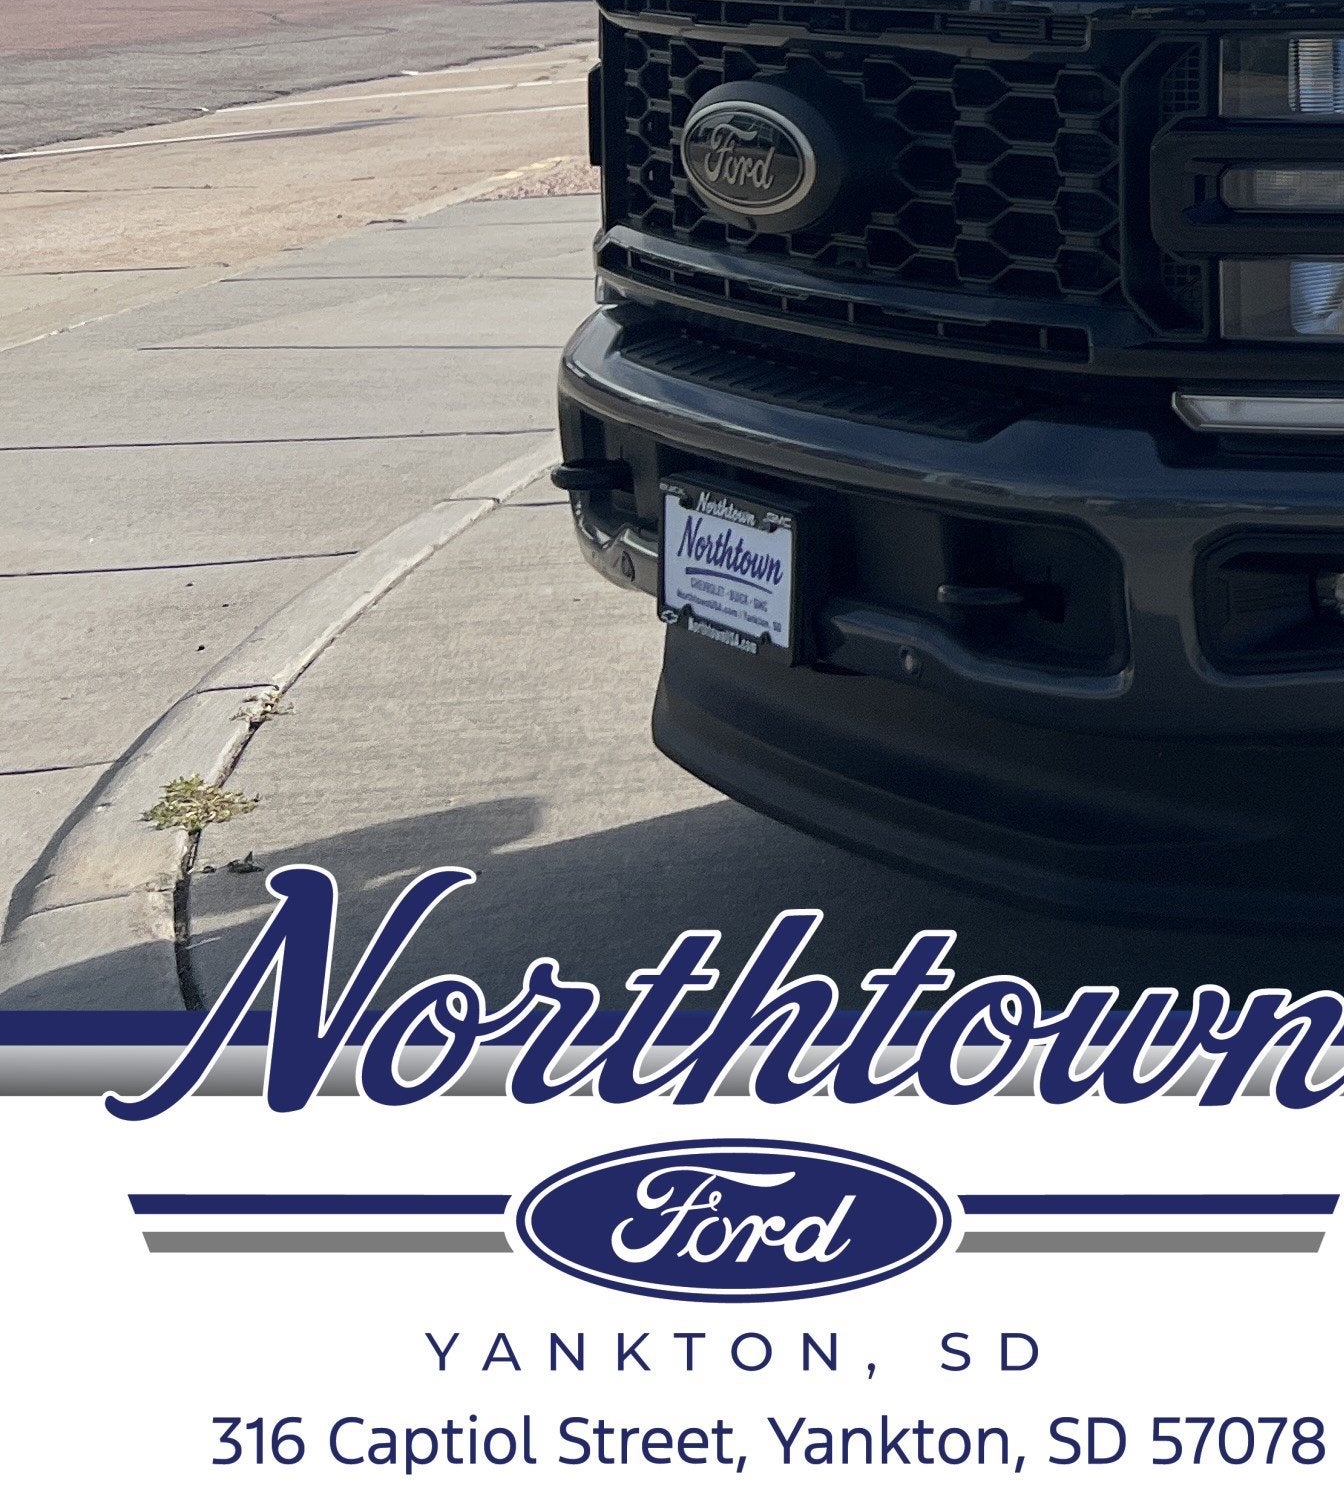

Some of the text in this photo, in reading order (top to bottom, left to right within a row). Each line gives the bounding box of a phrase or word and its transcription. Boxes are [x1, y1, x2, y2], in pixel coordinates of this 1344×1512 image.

[704, 123, 775, 189] Ford
[696, 491, 756, 527] Northtown
[677, 515, 783, 586] Northtown
